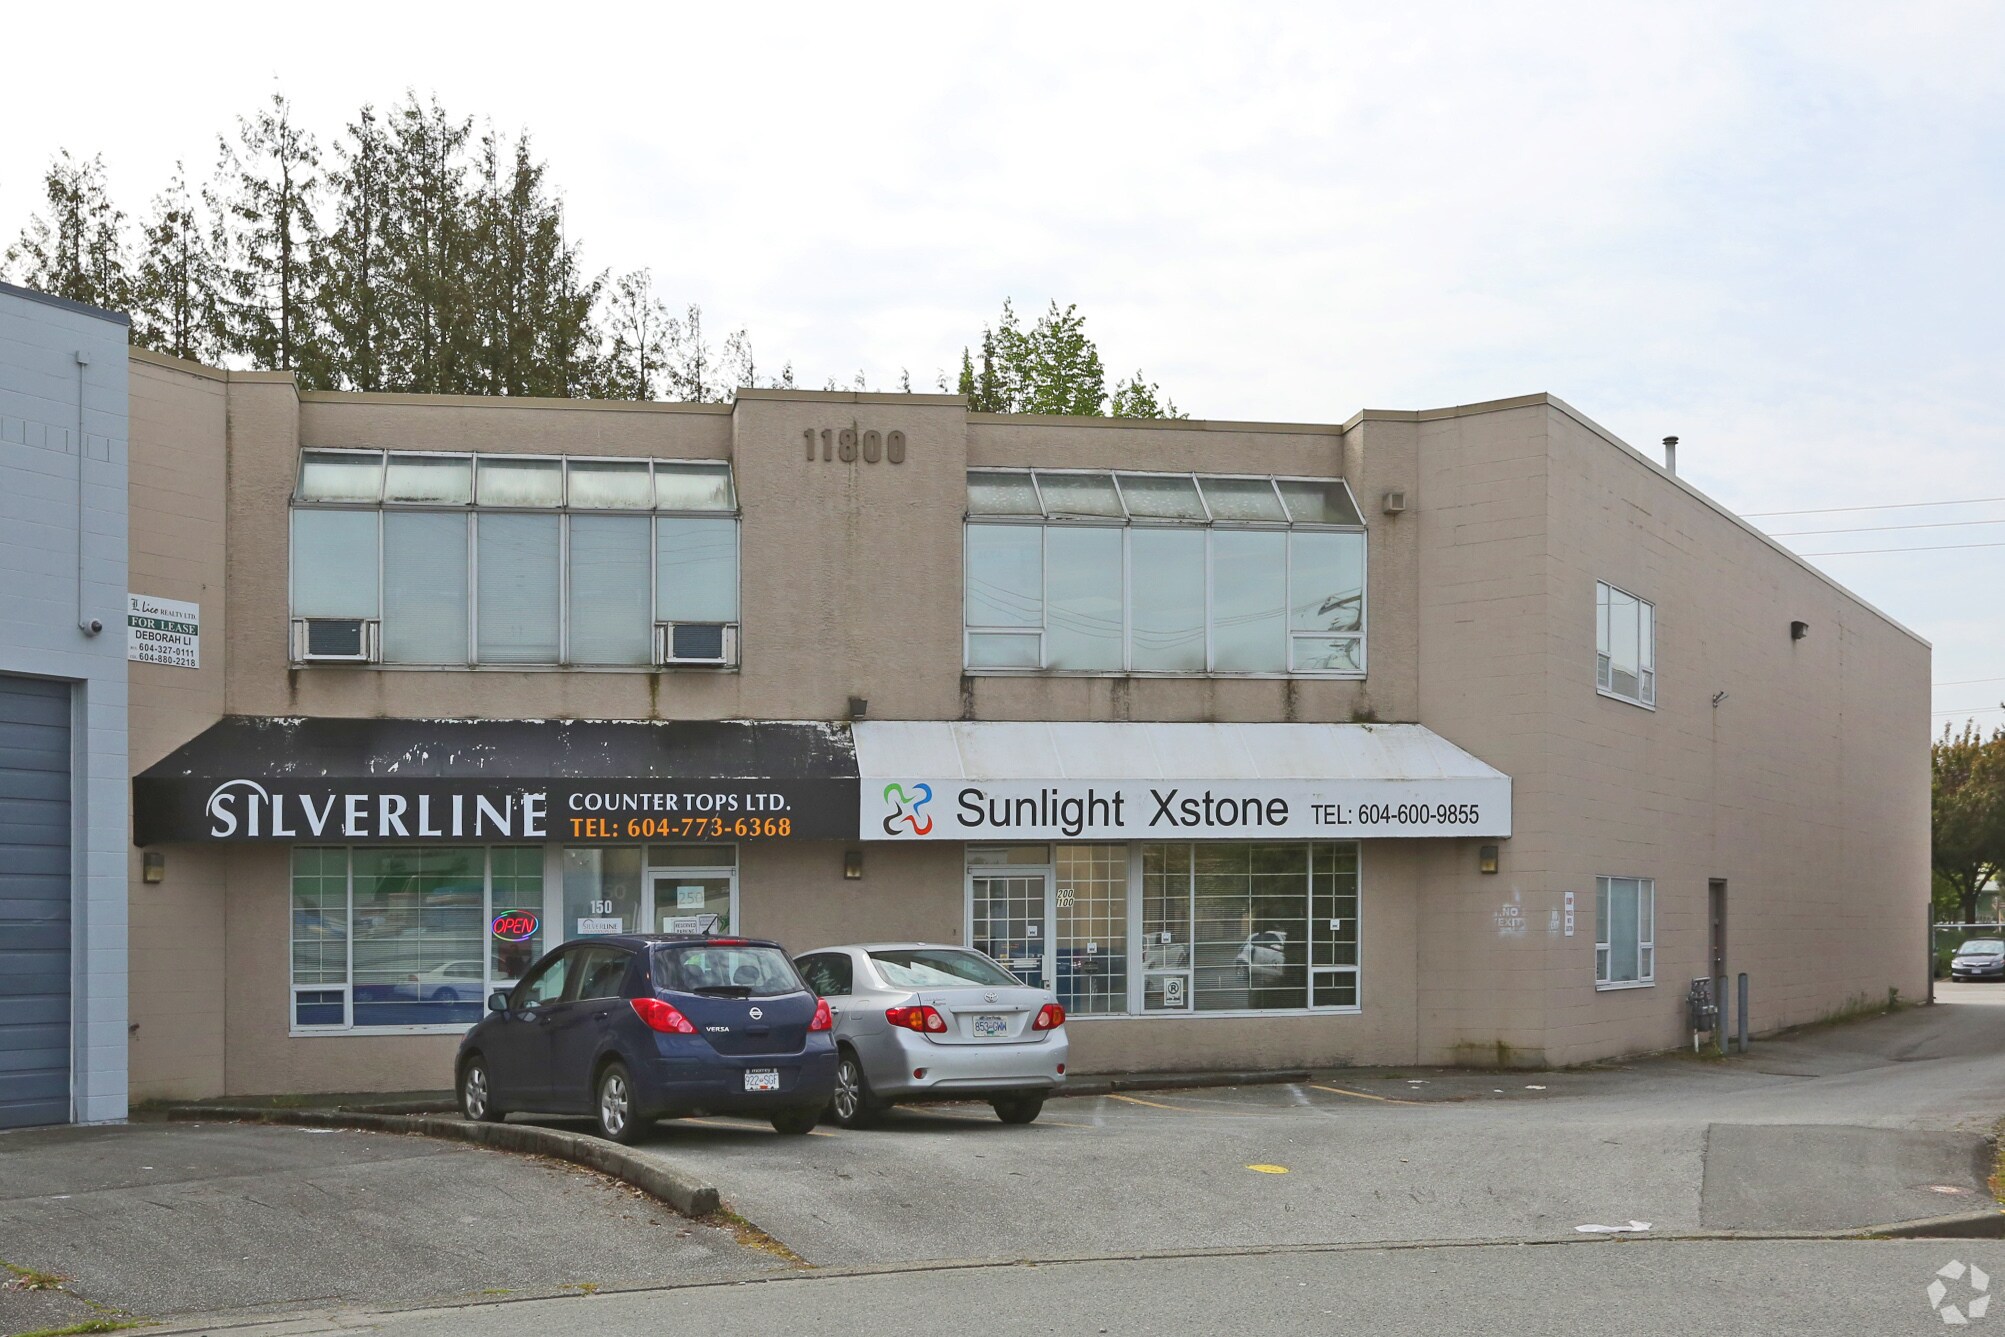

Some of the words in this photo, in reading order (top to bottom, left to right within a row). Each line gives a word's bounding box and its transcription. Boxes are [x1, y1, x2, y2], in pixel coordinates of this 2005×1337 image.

[804, 428, 905, 464] 11800
[160, 609, 182, 618] REALTY
[131, 616, 155, 628] FOR
[160, 620, 196, 634] LEASE
[135, 630, 181, 645] DEBORAH
[183, 637, 191, 646] LI
[139, 643, 194, 657] 604-327-0111
[139, 653, 196, 667] 604-880-2218
[568, 792, 678, 811] COUNTER
[685, 793, 739, 811] TOPS
[746, 793, 791, 811] LTD.
[208, 790, 546, 838] SILVERLINE
[957, 788, 1125, 837] Sunlight
[1149, 788, 1289, 828] Xstone
[1311, 804, 1353, 825] TEL:
[1358, 804, 1480, 825] 604-600-9855
[569, 818, 619, 837] TEL:
[627, 817, 792, 838] 604-773-6368
[678, 891, 704, 905] 250
[1057, 889, 1074, 898] 200
[590, 899, 613, 914] 150
[1502, 907, 1520, 917] NO
[493, 917, 535, 934] OPEN
[975, 1021, 989, 1031] 853
